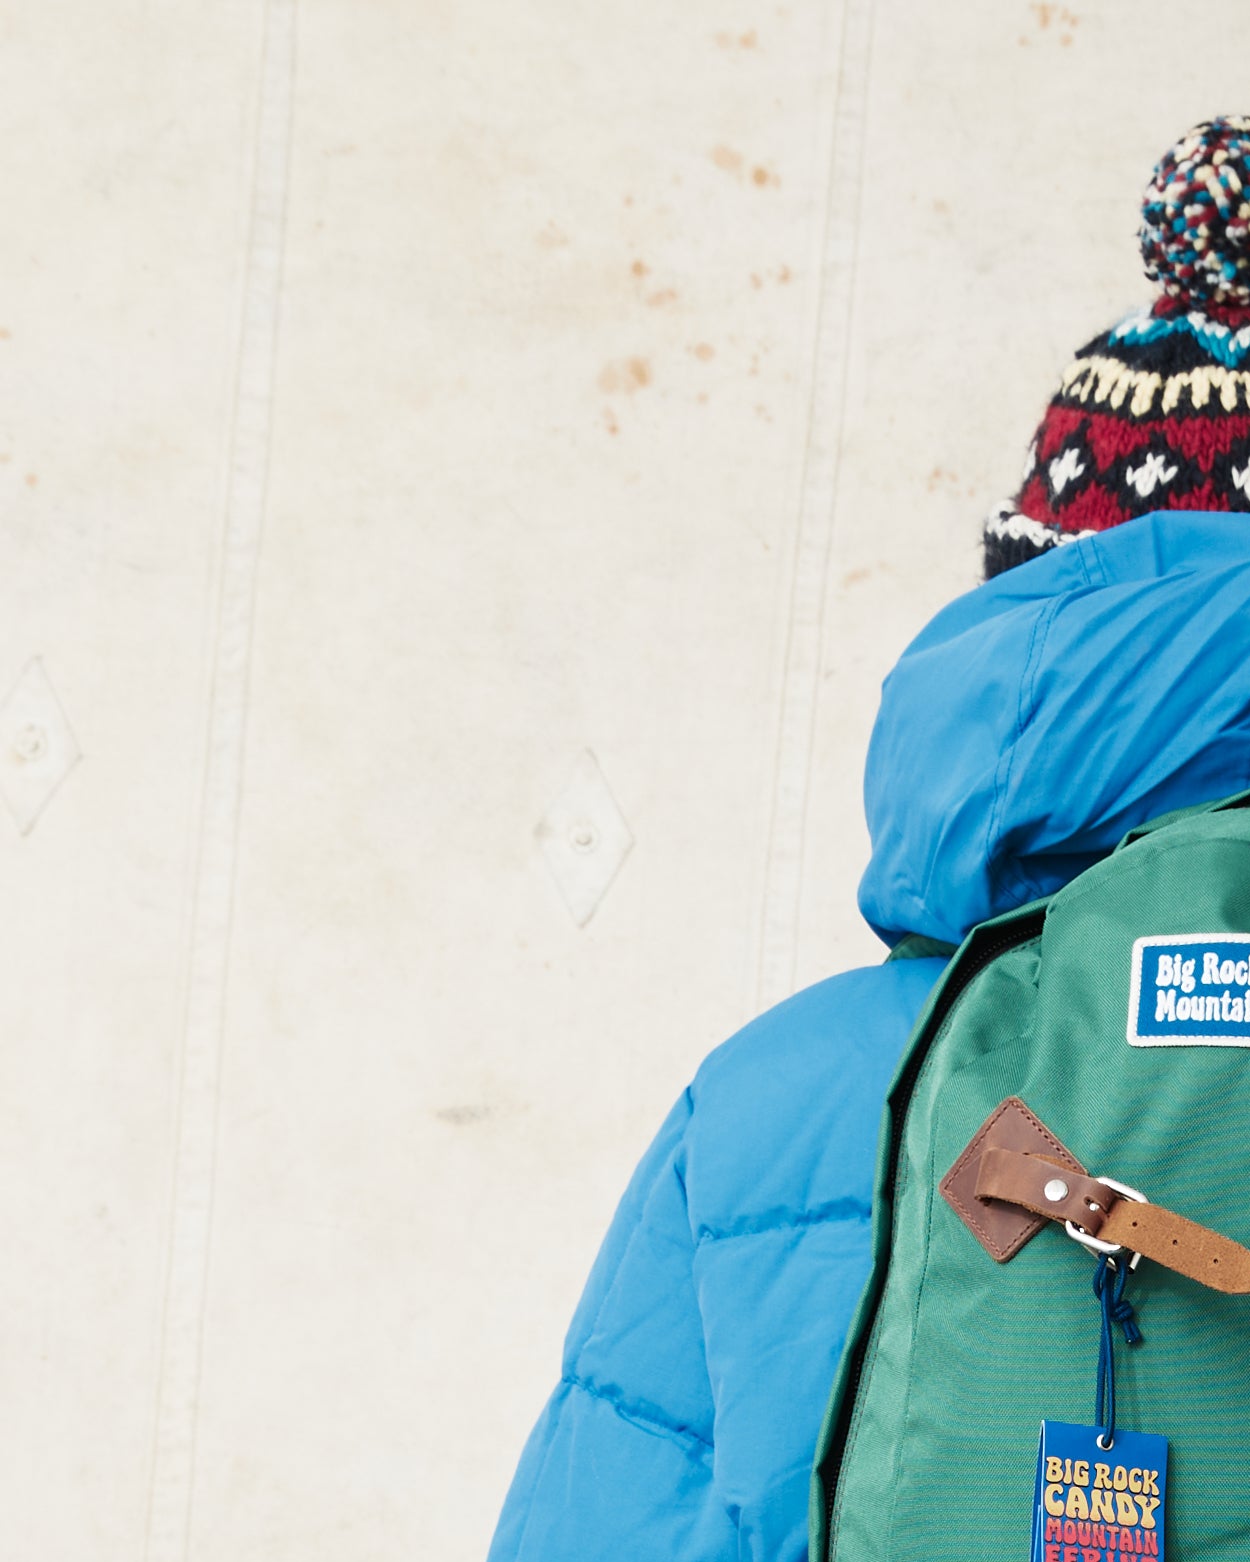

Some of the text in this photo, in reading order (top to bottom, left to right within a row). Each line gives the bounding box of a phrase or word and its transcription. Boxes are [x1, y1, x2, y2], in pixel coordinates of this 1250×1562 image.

[1155, 954, 1196, 993] Big
[1045, 1456, 1160, 1496] BIG ROCK
[1044, 1484, 1161, 1529] CANDY
[1045, 1518, 1158, 1556] MOUNTAIN
